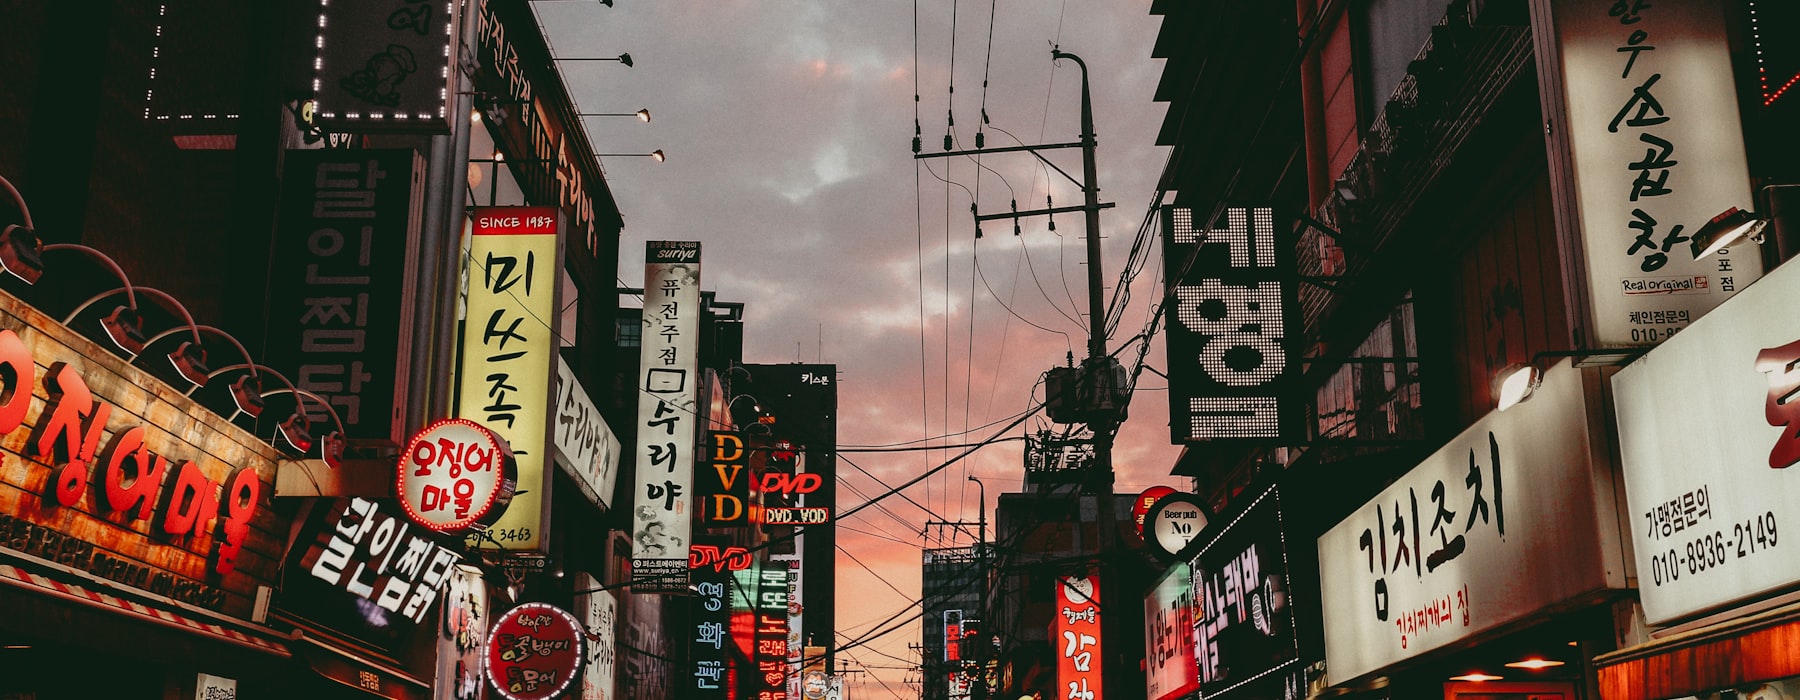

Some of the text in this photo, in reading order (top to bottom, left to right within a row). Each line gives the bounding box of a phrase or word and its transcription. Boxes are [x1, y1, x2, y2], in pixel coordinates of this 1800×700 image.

[479, 216, 554, 229] SINCE 1987
[657, 247, 697, 262] suriya
[1622, 279, 1647, 291] Real
[659, 277, 682, 367] 퓨전주점
[1629, 309, 1690, 325] 체인점문의
[412, 437, 494, 480] 오징어
[647, 399, 685, 512] 수리야
[712, 433, 744, 522] DVD
[759, 472, 824, 494] DVD
[420, 478, 475, 520] 마을
[1164, 510, 1197, 519] Beer pub
[1645, 484, 1713, 541] 가맹점문의
[499, 527, 532, 542] 3463
[1359, 430, 1506, 623] 김치조치
[311, 496, 459, 625] 달인찜닭
[690, 544, 752, 572] DVD
[1651, 510, 1779, 587] 010-8936-2149
[1062, 606, 1096, 624] 형제들
[1396, 583, 1471, 650] 김치찌개의 집
